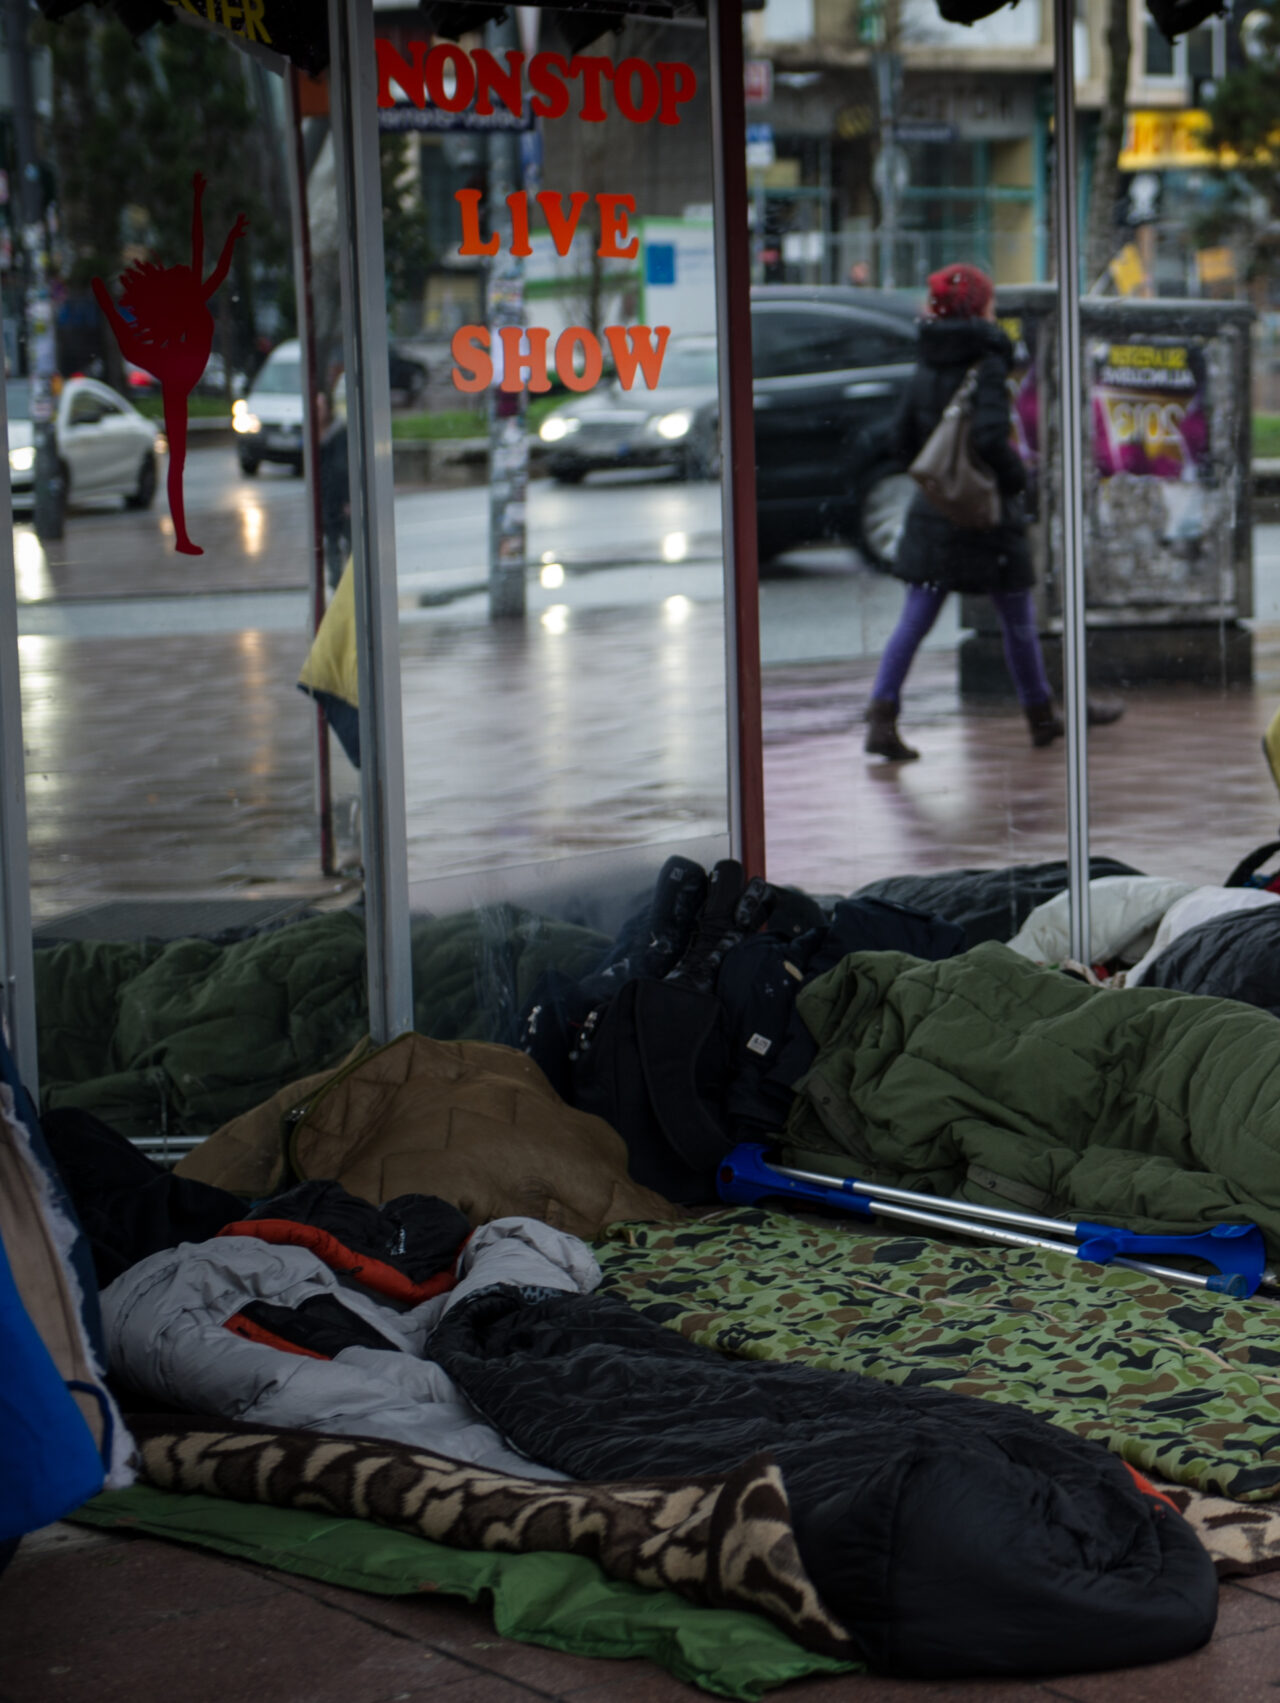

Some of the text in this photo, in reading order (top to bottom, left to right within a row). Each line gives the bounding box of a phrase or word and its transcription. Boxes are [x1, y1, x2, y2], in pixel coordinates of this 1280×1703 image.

[375, 38, 697, 126] NONSTOP
[454, 188, 640, 259] LIVE
[451, 324, 671, 393] SHOW
